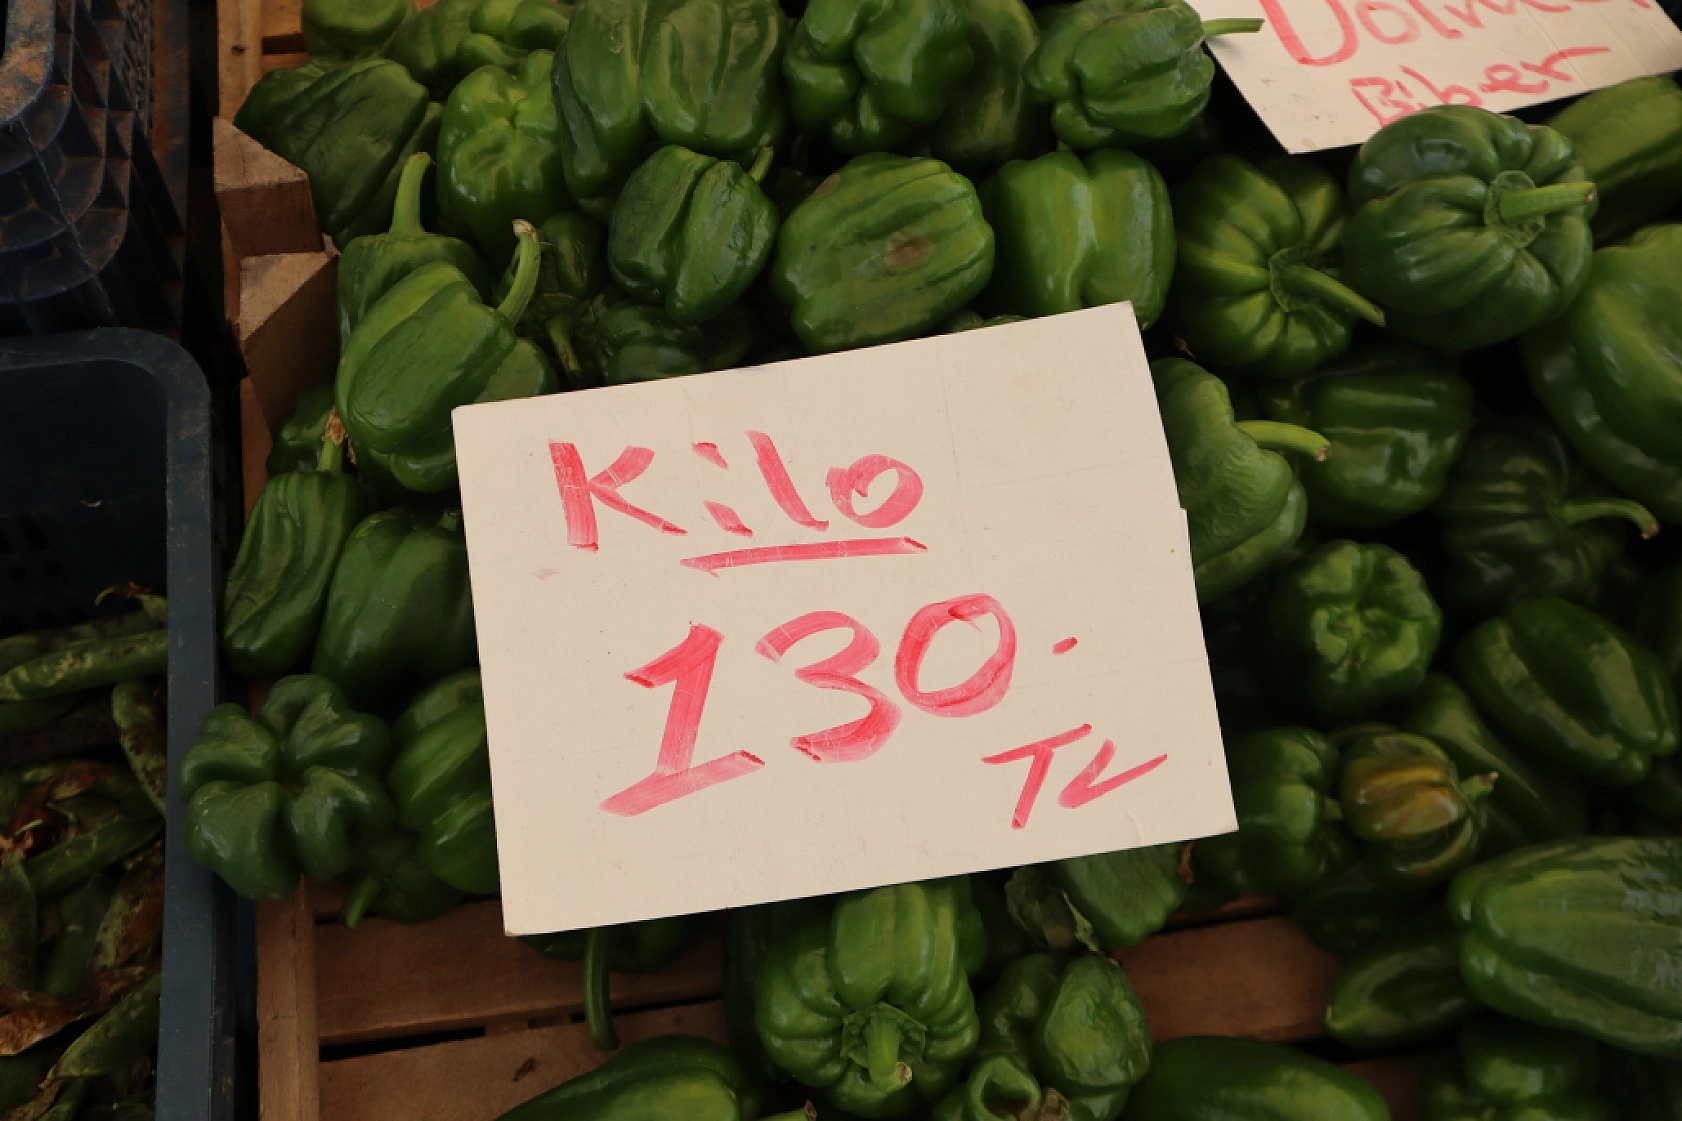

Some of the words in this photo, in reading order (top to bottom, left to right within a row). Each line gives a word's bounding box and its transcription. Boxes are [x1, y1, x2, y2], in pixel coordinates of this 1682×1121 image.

[1349, 45, 1611, 128] Biber
[548, 430, 924, 553] Kilo
[981, 723, 1168, 830] TL
